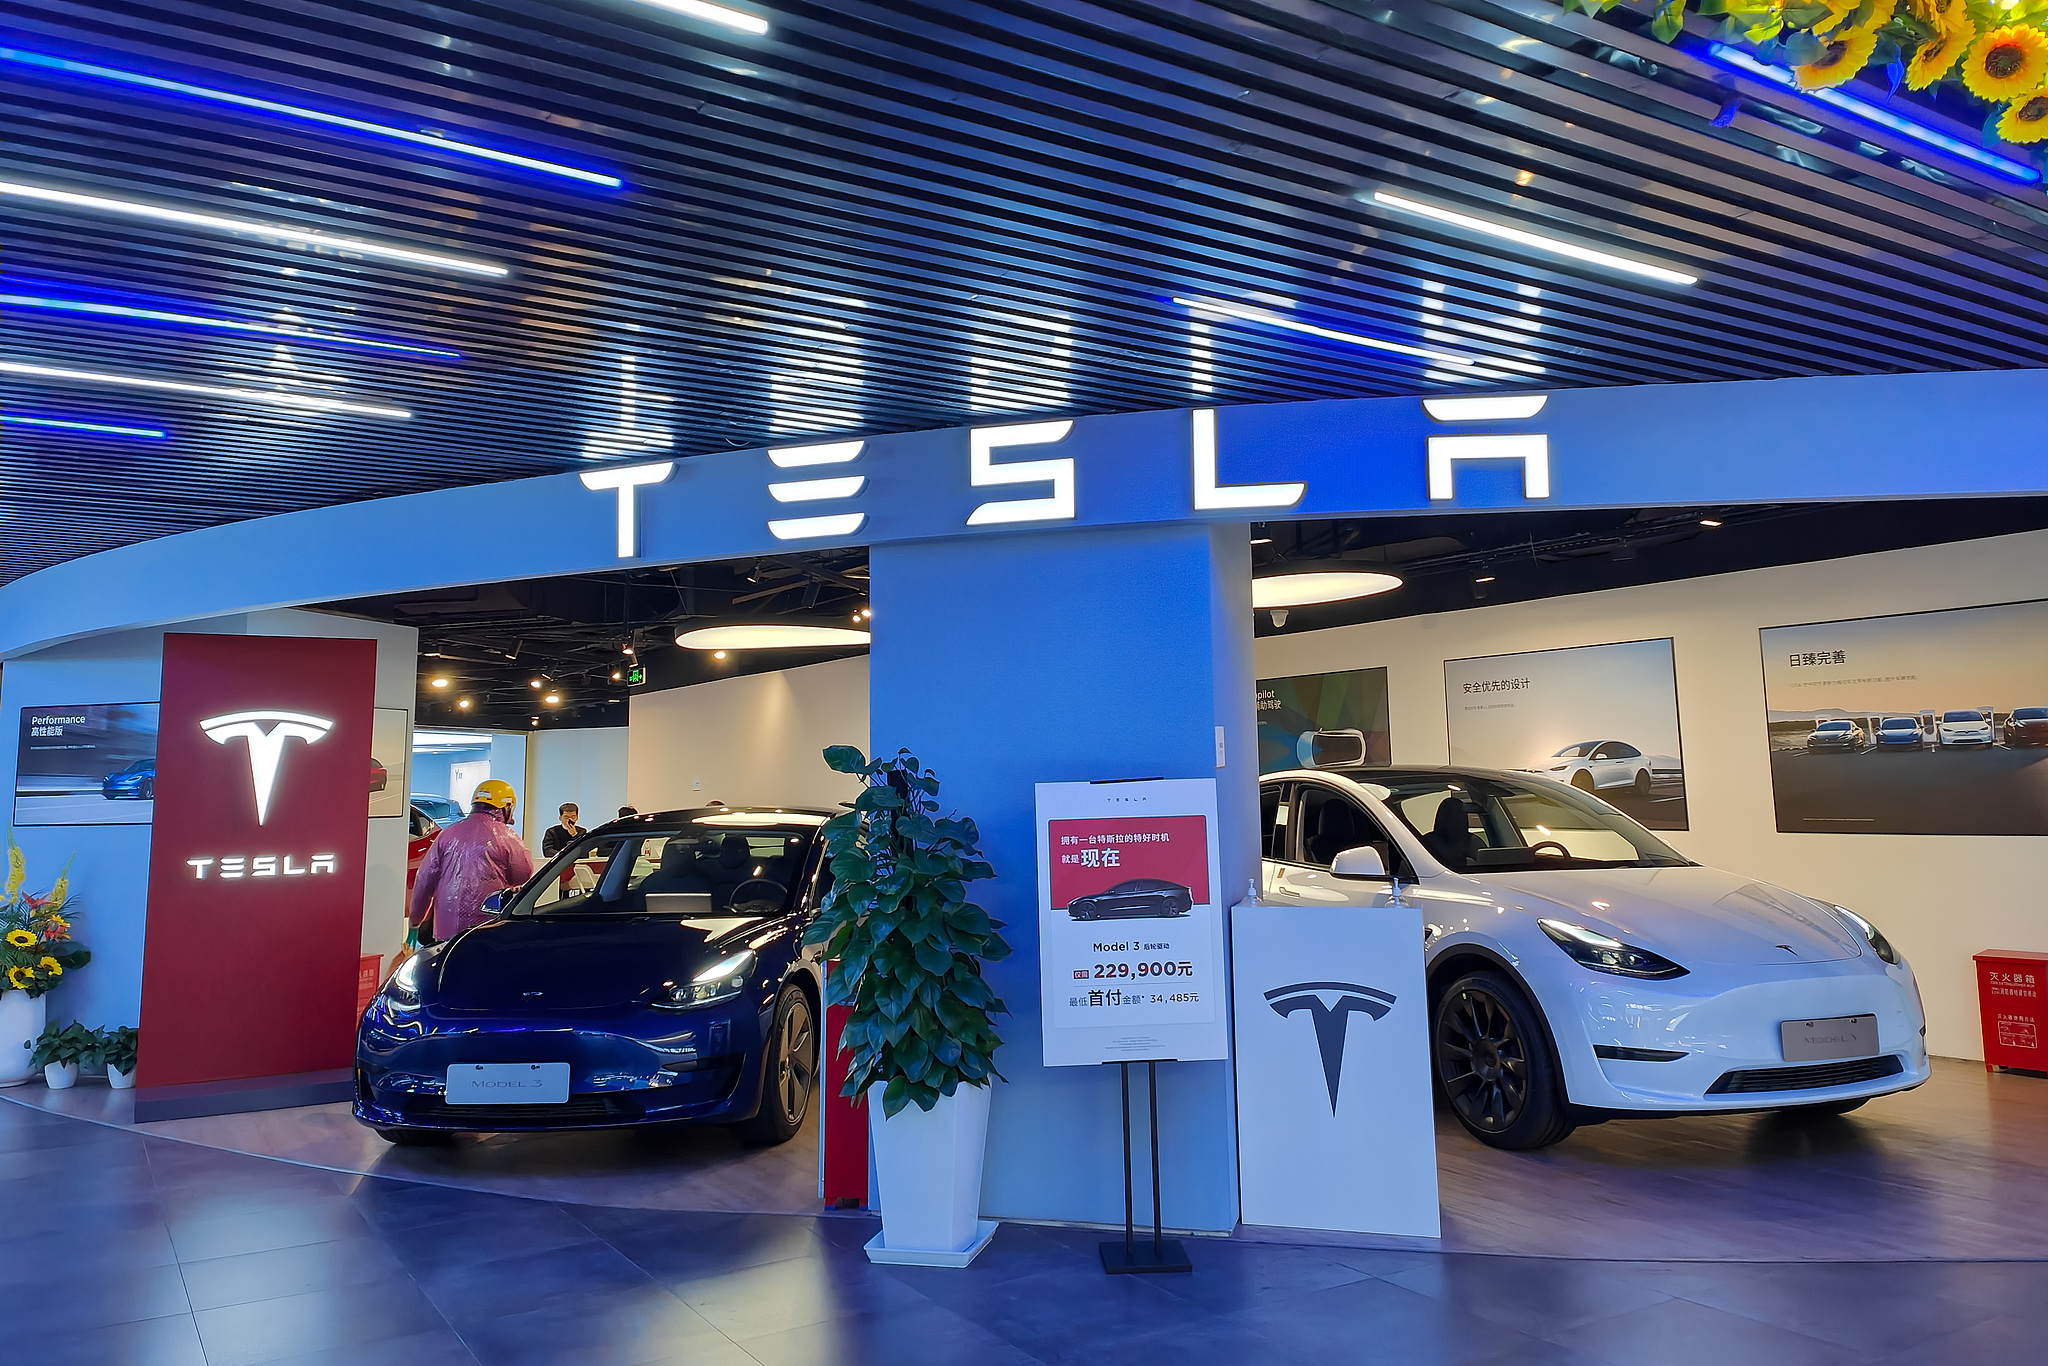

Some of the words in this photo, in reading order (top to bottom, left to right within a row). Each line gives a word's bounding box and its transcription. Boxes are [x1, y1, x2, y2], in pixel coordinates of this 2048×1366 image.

[579, 394, 1550, 558] TESLA
[1790, 650, 1846, 667] 日臻完善
[1462, 677, 1531, 694] 安全优先的设计
[31, 715, 86, 725] Performance
[31, 726, 63, 737] 高性能版
[1060, 833, 1170, 846] 拥有一台特斯拉的特好时机
[1061, 847, 1121, 868] 就是现在
[186, 854, 335, 879] TESLA
[1093, 942, 1129, 952] Model
[1133, 942, 1140, 951] 3
[1093, 961, 1193, 980] 229,900元
[1989, 971, 2035, 985] 灭火器箱
[1150, 992, 1200, 1004] 34,485元
[1804, 1035, 1849, 1044] MODEL
[471, 1080, 527, 1088] MODEL
[531, 1080, 542, 1088] 3
